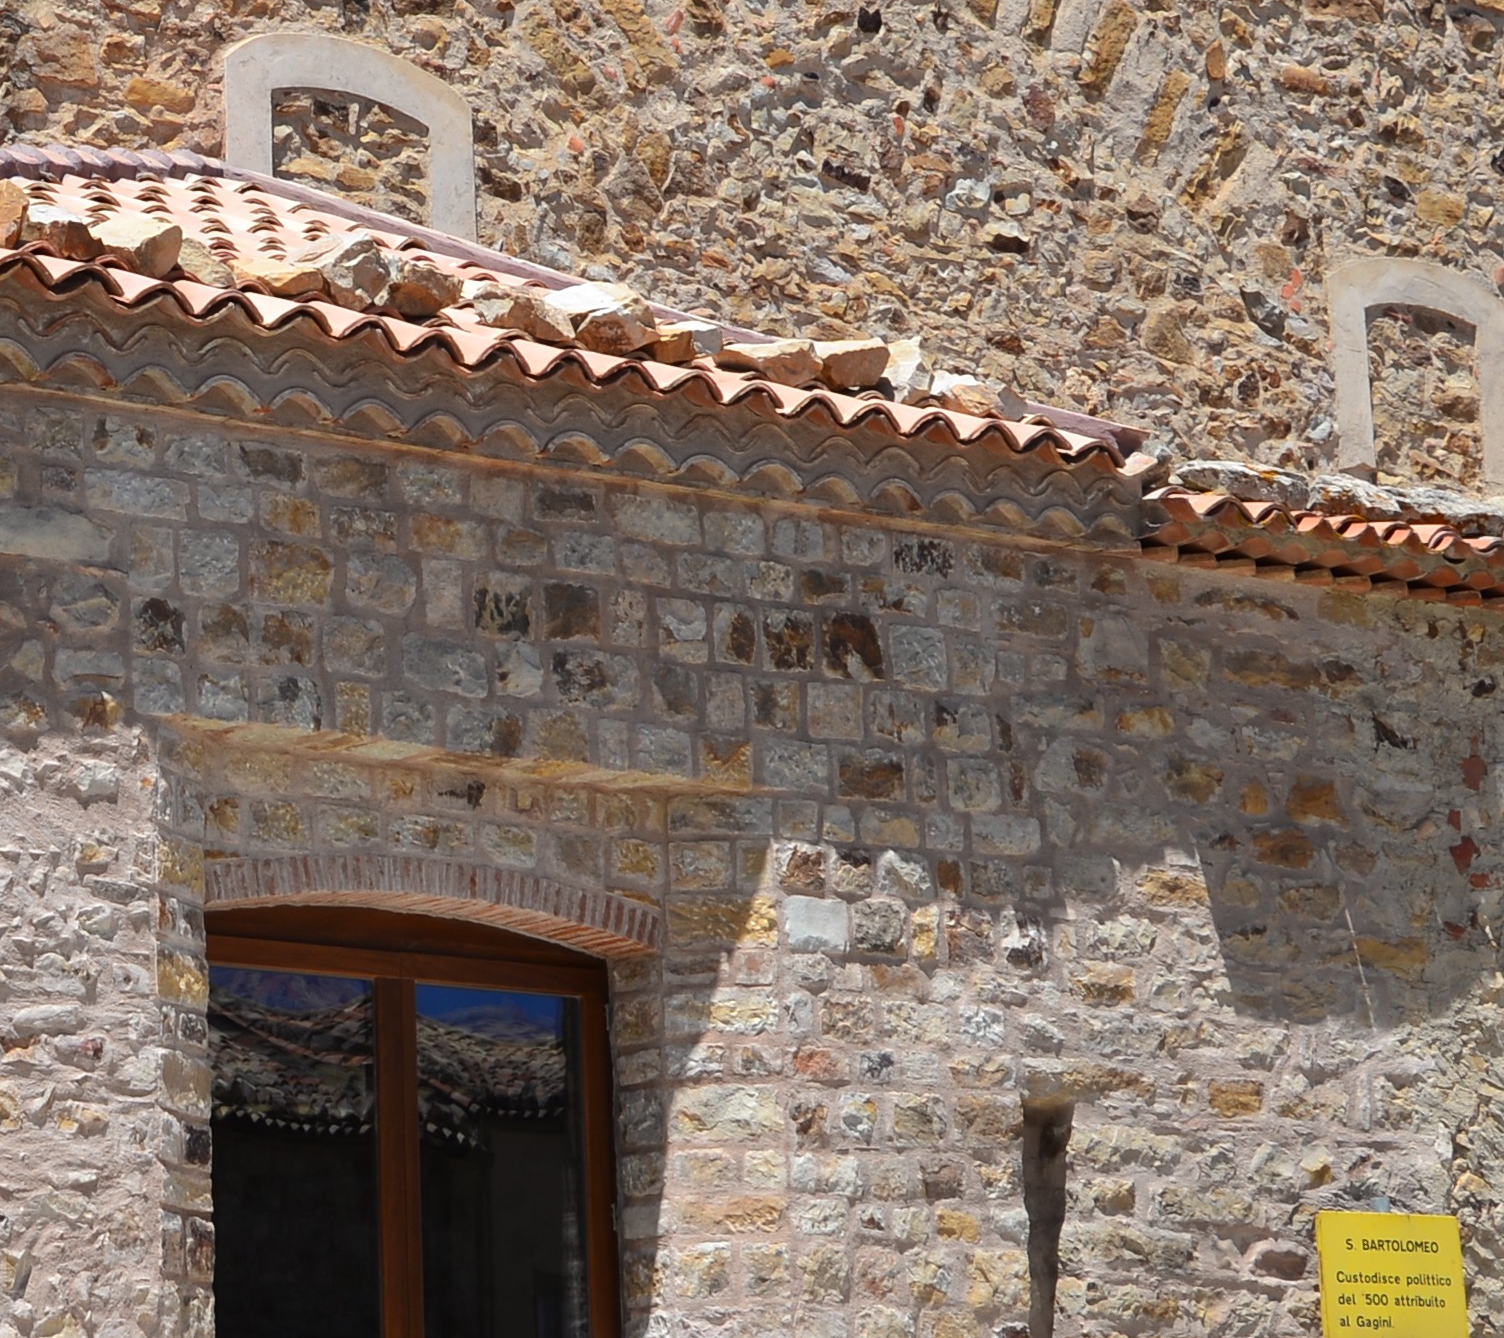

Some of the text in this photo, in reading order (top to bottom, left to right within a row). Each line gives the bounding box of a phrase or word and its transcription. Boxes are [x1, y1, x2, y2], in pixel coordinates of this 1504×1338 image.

[1345, 1238, 1439, 1254] S. BARTOLOMEO
[1336, 1270, 1452, 1287] Custodisce polittico
[1338, 1293, 1356, 1306] del
[1394, 1295, 1446, 1308] attribuito
[1339, 1315, 1350, 1327] al
